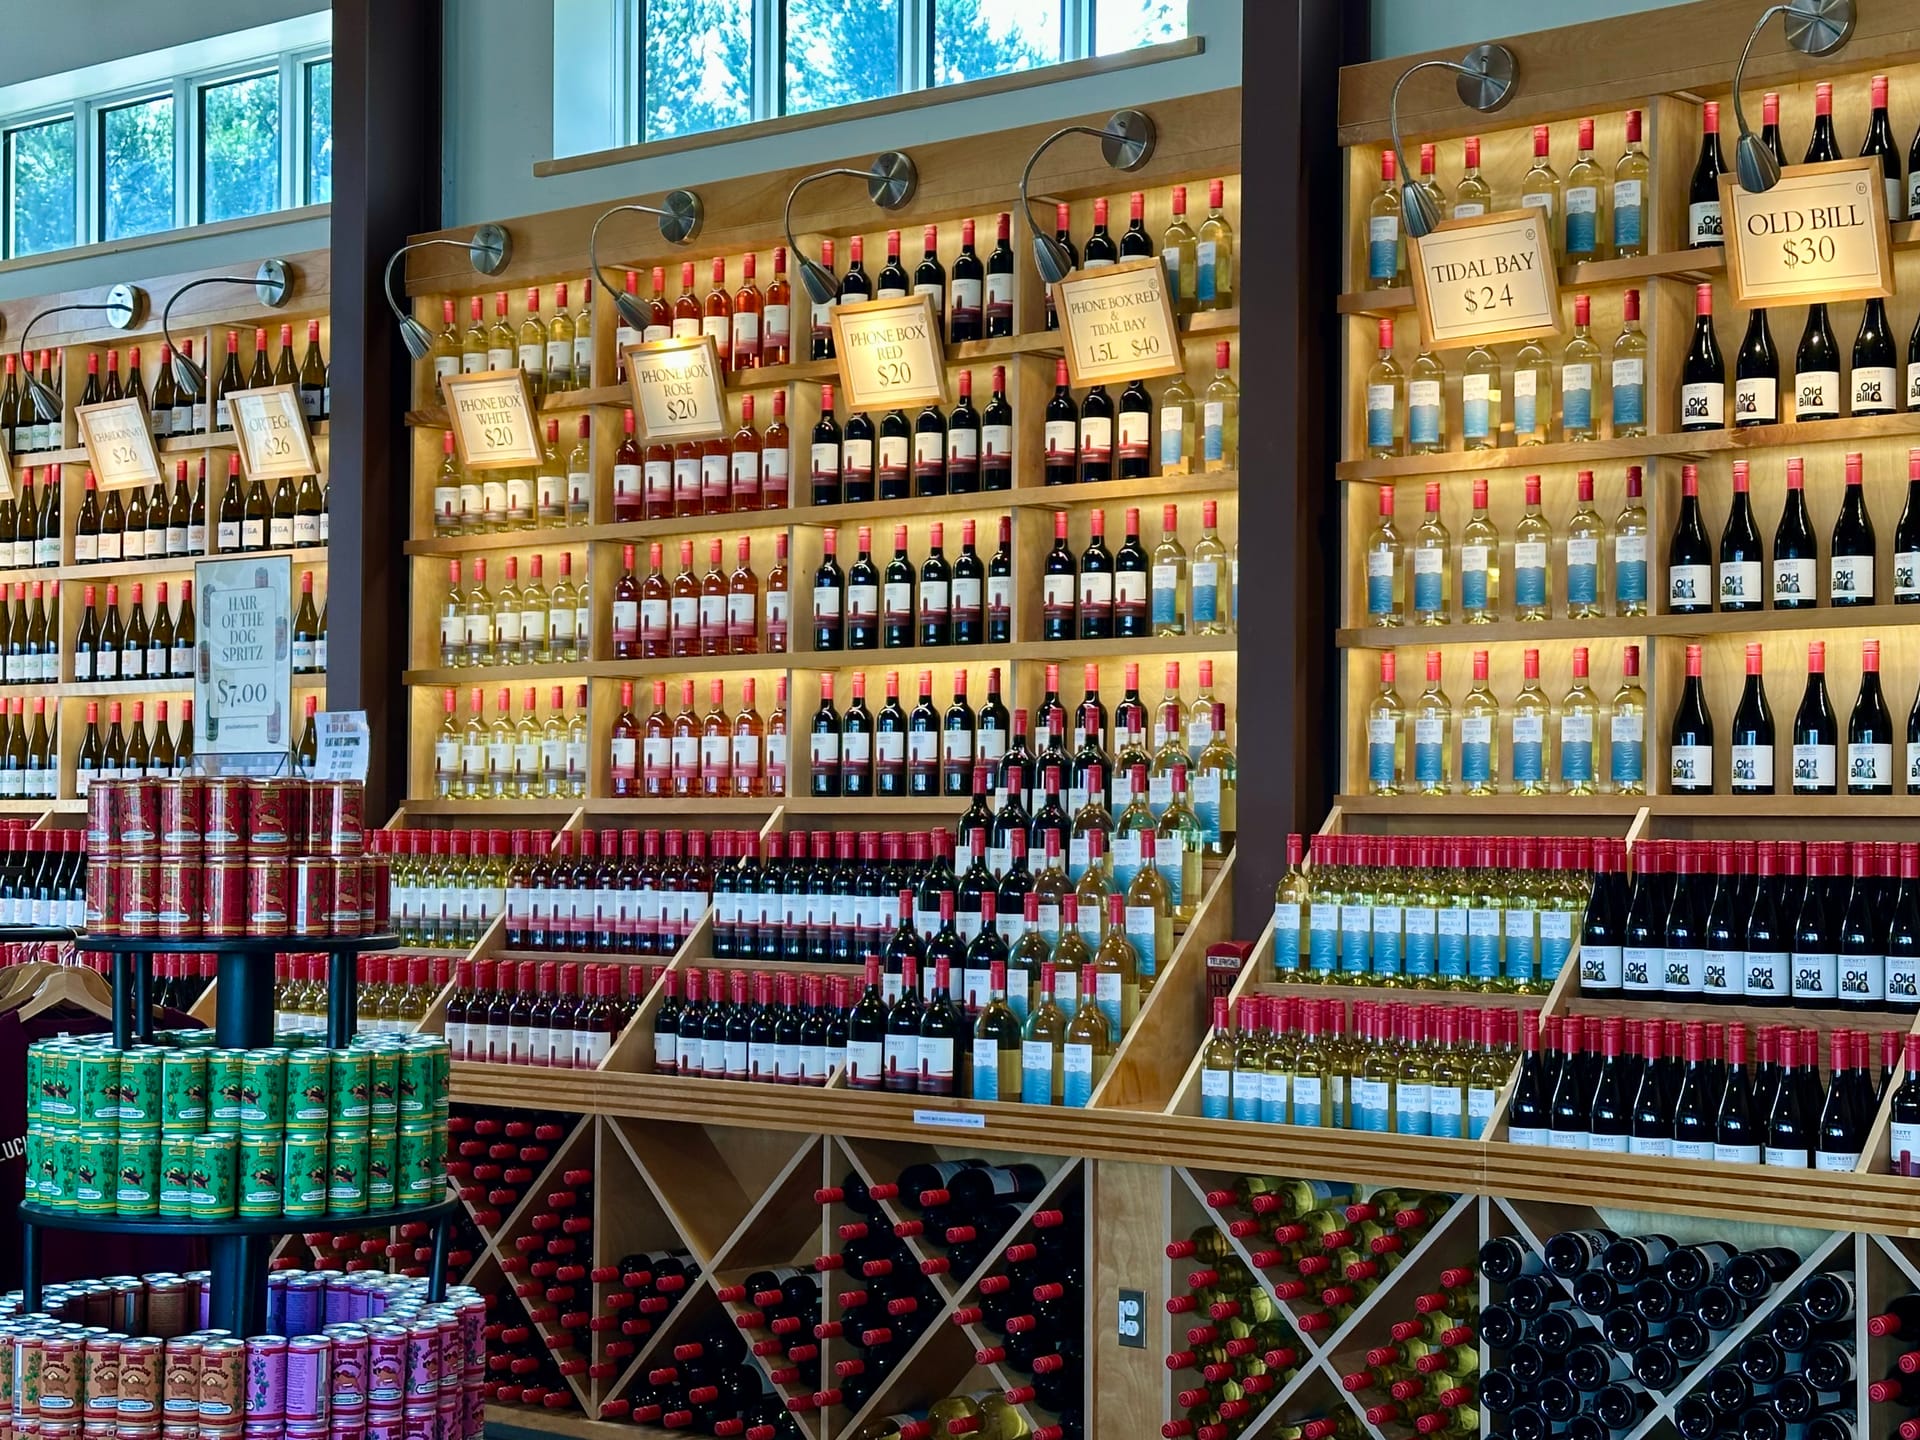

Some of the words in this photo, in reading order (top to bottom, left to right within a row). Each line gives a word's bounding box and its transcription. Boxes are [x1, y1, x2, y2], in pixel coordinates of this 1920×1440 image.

[1747, 210, 1804, 236] OLD
[1808, 204, 1864, 230] BILL
[1697, 225, 1712, 235] Bill
[1784, 235, 1836, 270] $30
[1432, 259, 1492, 283] TIDAL
[1495, 252, 1534, 274] BAY
[1071, 298, 1107, 314] PHONE
[1108, 294, 1134, 309] BOX
[1136, 290, 1160, 304] RED
[1464, 283, 1514, 315] $24
[1110, 310, 1119, 320] &
[1090, 322, 1122, 336] TIDAL
[1124, 317, 1146, 332] BAY
[850, 328, 895, 346] PHONE
[896, 325, 926, 342] BOX
[878, 345, 903, 360] RED
[1090, 342, 1118, 362] 1.5L
[1132, 336, 1160, 357] $40
[642, 368, 682, 384] PHONE
[684, 364, 708, 380] BOX
[878, 362, 912, 386] $20
[664, 382, 694, 396] ROSE
[1803, 387, 1822, 397] Old
[1861, 382, 1880, 392] Old
[1739, 393, 1755, 403] Old
[1856, 391, 1870, 401] Bill
[460, 398, 498, 412] PHONE
[498, 395, 521, 408] BOX
[1688, 398, 1707, 407] Old
[1799, 397, 1812, 407] Bill
[667, 398, 698, 421] $20
[1685, 406, 1698, 417] Bill
[476, 411, 512, 425] WHITE
[485, 426, 513, 448] $20
[265, 435, 290, 457] $26
[112, 446, 137, 464] $26
[1836, 570, 1853, 580] Old
[1897, 567, 1913, 577] Old
[1725, 576, 1742, 585] Old
[1780, 573, 1799, 583] Old
[1676, 579, 1694, 588] Old
[1776, 583, 1789, 593] Bill
[1673, 589, 1685, 598] Bill
[228, 595, 258, 612] HAIR
[222, 614, 238, 629] OF
[240, 612, 264, 628] THE
[230, 628, 256, 645] DOG
[222, 645, 263, 662] SPRITZ
[218, 680, 267, 708] $7.00
[1676, 759, 1693, 768] Old
[1736, 759, 1754, 768] Old
[1798, 759, 1816, 768] Old
[1855, 758, 1874, 768] Old
[1586, 960, 1604, 970] Old
[1628, 962, 1646, 972] Old
[1669, 964, 1688, 974] Old
[1706, 966, 1725, 976] Old
[1752, 968, 1772, 977] Old
[1800, 969, 1820, 980] Old
[1846, 971, 1867, 981] Old
[1625, 972, 1636, 982] Bill
[1665, 973, 1678, 983] Bill
[1894, 973, 1915, 983] Old
[1748, 978, 1762, 987] Bill
[1796, 980, 1810, 990] Bill
[1842, 981, 1856, 991] Bill
[1889, 983, 1903, 993] Bill
